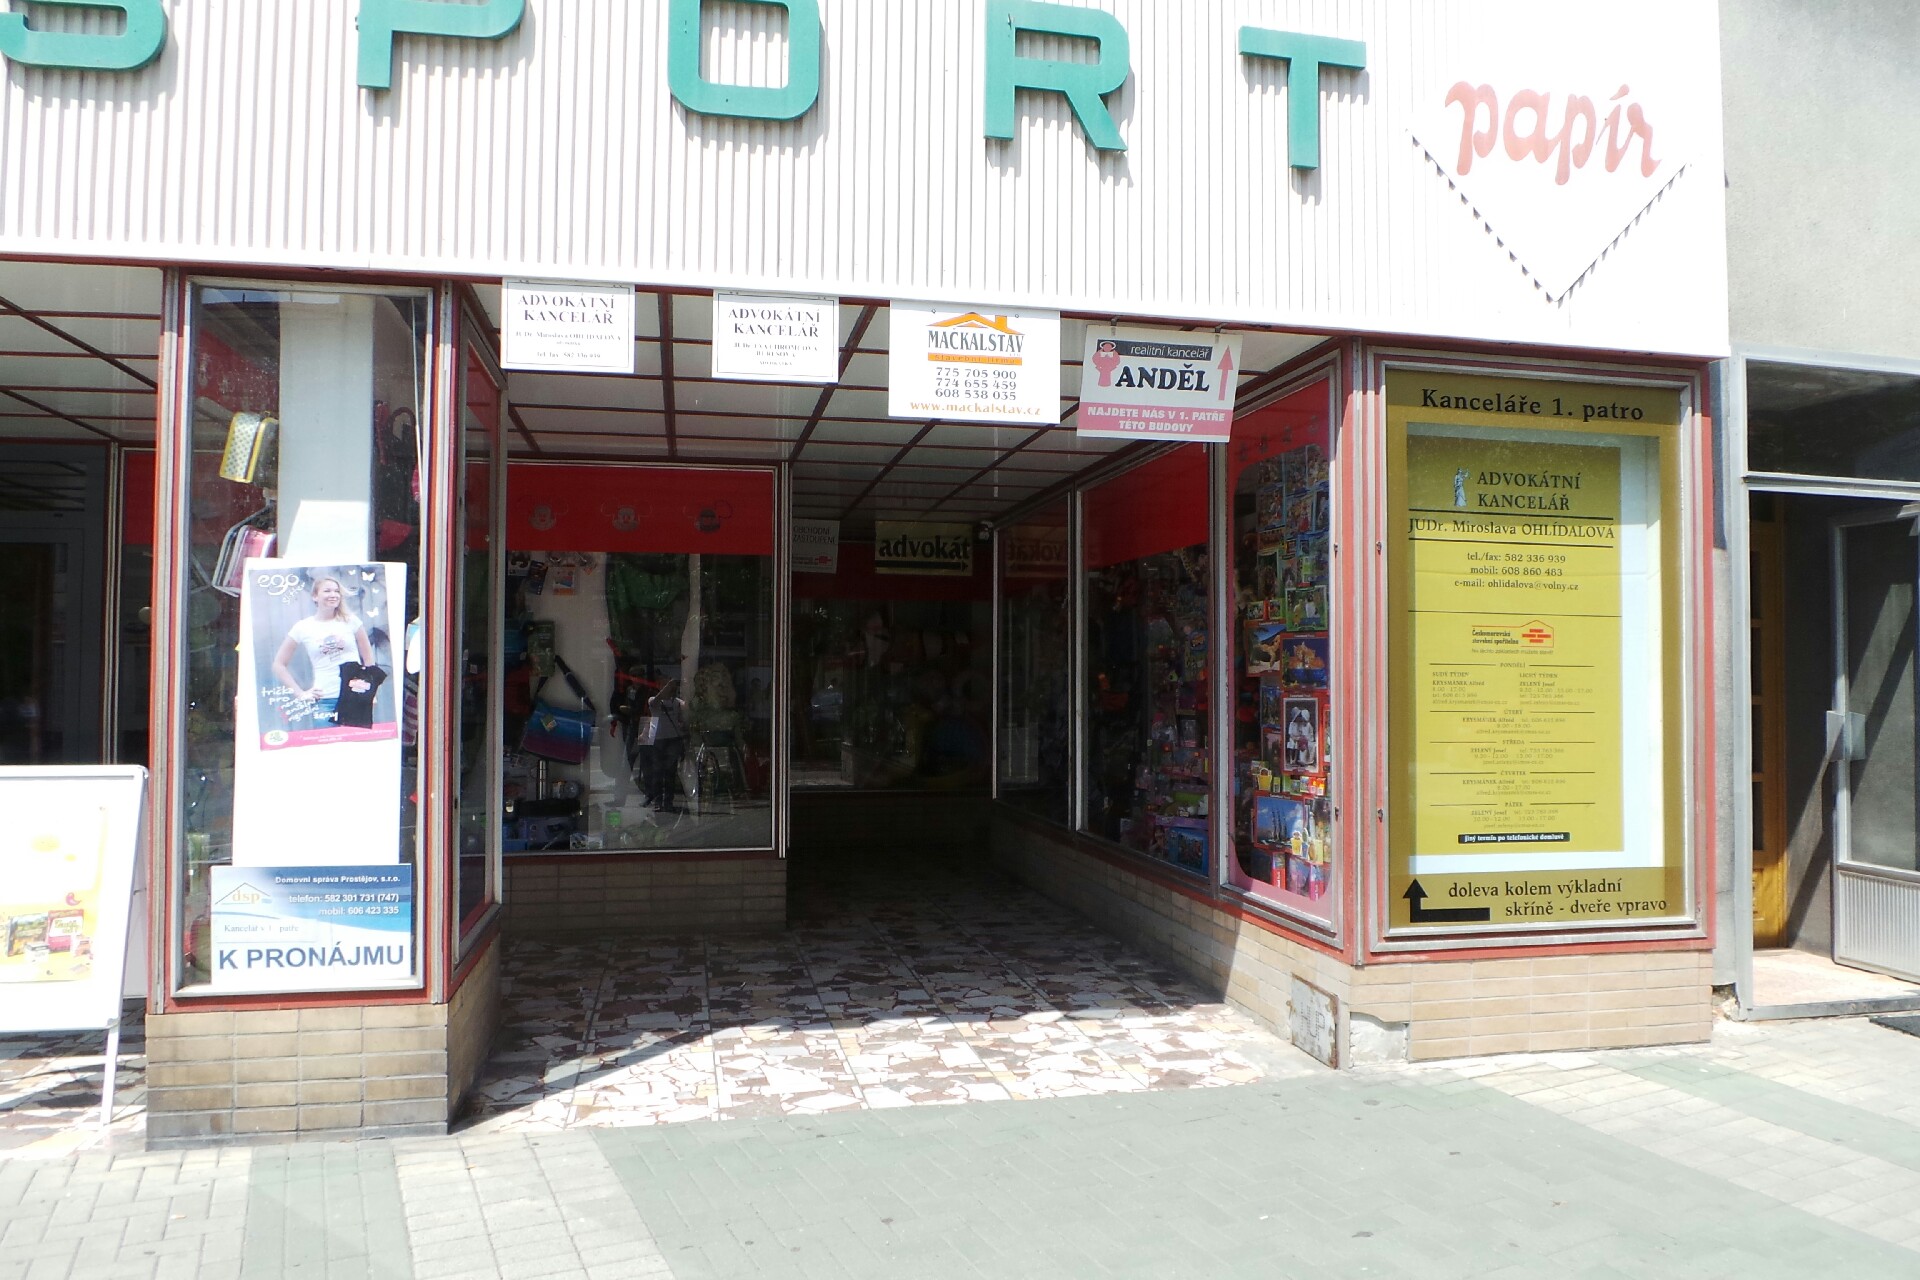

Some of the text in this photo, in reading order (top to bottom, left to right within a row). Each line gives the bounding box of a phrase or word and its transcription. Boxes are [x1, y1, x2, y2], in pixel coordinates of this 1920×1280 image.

[1445, 81, 1662, 185] papír
[518, 293, 615, 309] ADVOKÁTNÍ
[524, 309, 614, 324] KANCELÁŘ
[728, 306, 820, 322] ADVOKÁTNÍ
[734, 322, 819, 338] KANCELÁŘ
[1131, 345, 1210, 359] realitní kancelář
[936, 366, 1017, 380] 775 705 900
[1115, 363, 1210, 392] ANDĚL
[936, 378, 1017, 390] 774 655 459
[936, 388, 1017, 401] 608 538 035
[910, 402, 1042, 416] www.mackalstav.cz
[1422, 388, 1644, 422] Kanceláře 1. patro
[1088, 406, 1226, 422] NAJDETE NÁS V 1. PATŘE
[1119, 418, 1194, 432] TÉTO BUDOVY
[1477, 470, 1582, 490] ADVOKÁTNÍ
[1478, 493, 1571, 512] KANCELÁŘ
[1408, 518, 1615, 538] JUDr. Miroslava OHLÍDALOVÁ
[879, 534, 970, 560] advokát
[1467, 552, 1566, 564] tel./fax: 582 336 939
[1470, 566, 1563, 576] mobil: 608 860 483
[258, 574, 300, 596] ego
[1454, 578, 1578, 592] e-mail: ohlidalova@volny.cz
[276, 876, 310, 884] Domovní
[312, 876, 338, 884] správa
[1448, 878, 1622, 898] doleva kolem výkladní
[232, 890, 260, 904] dsp
[289, 894, 400, 903] telefon: 582 301 731 (747)
[319, 908, 346, 916] mobil:
[383, 906, 400, 914] 335
[1505, 900, 1554, 916] skříně
[1570, 899, 1611, 914] dveře
[1617, 900, 1667, 914] vpravo
[219, 941, 404, 970] K PRONÁJMU
